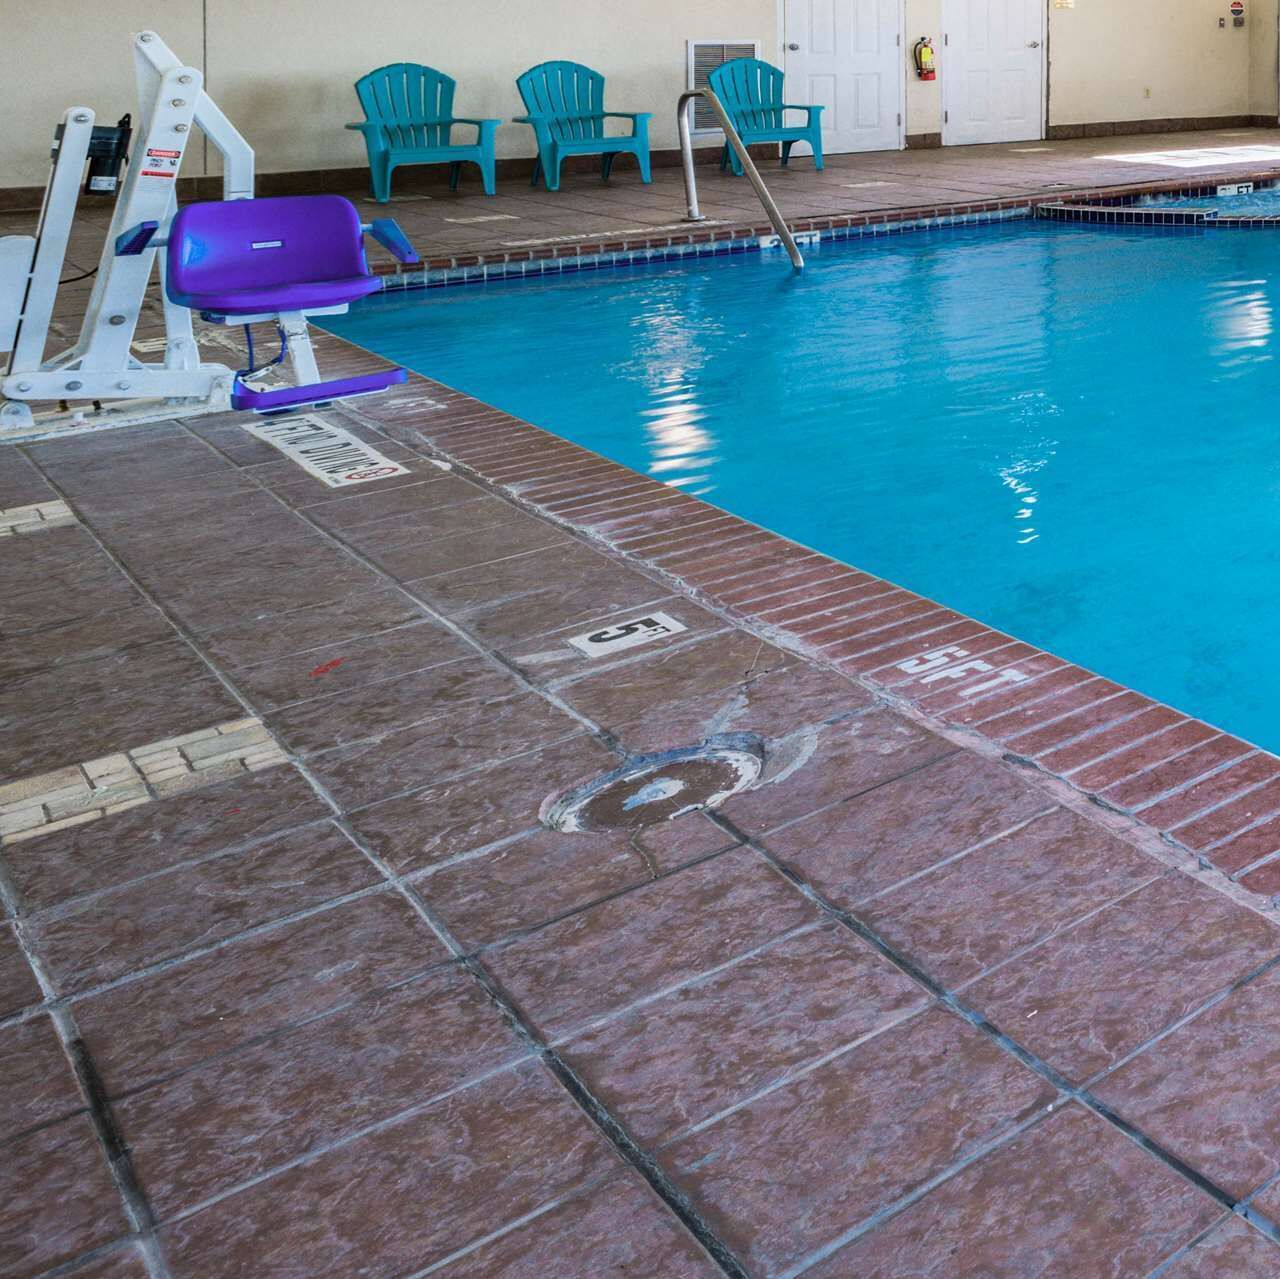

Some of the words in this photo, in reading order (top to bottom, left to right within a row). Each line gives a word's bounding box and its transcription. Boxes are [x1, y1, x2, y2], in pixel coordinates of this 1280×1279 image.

[299, 442, 380, 474] DIVING
[588, 618, 661, 643] 5
[642, 626, 672, 637] FT
